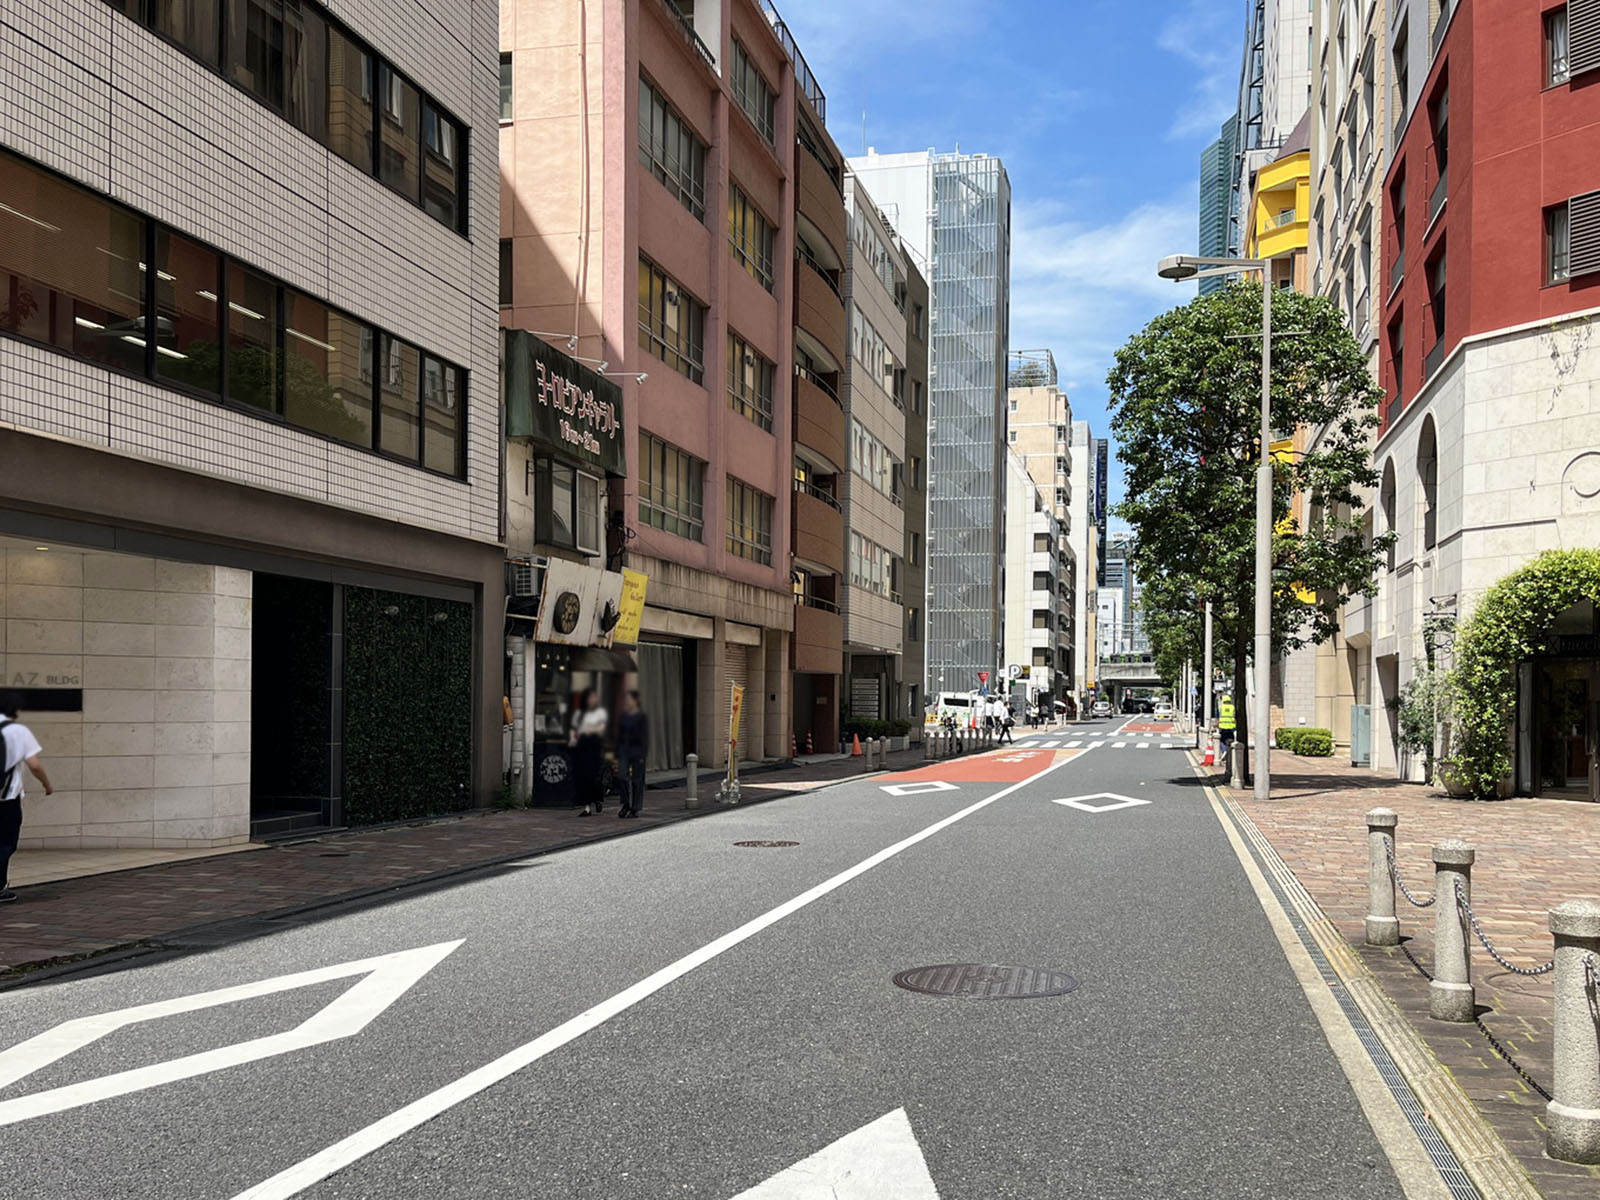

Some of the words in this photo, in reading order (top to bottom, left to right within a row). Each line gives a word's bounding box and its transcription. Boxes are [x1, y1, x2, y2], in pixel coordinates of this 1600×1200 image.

[535, 359, 620, 439] ヨーロピアンギャラリー
[12, 672, 40, 685] AZ
[46, 675, 79, 685] BLDG
[1009, 664, 1022, 680] P
